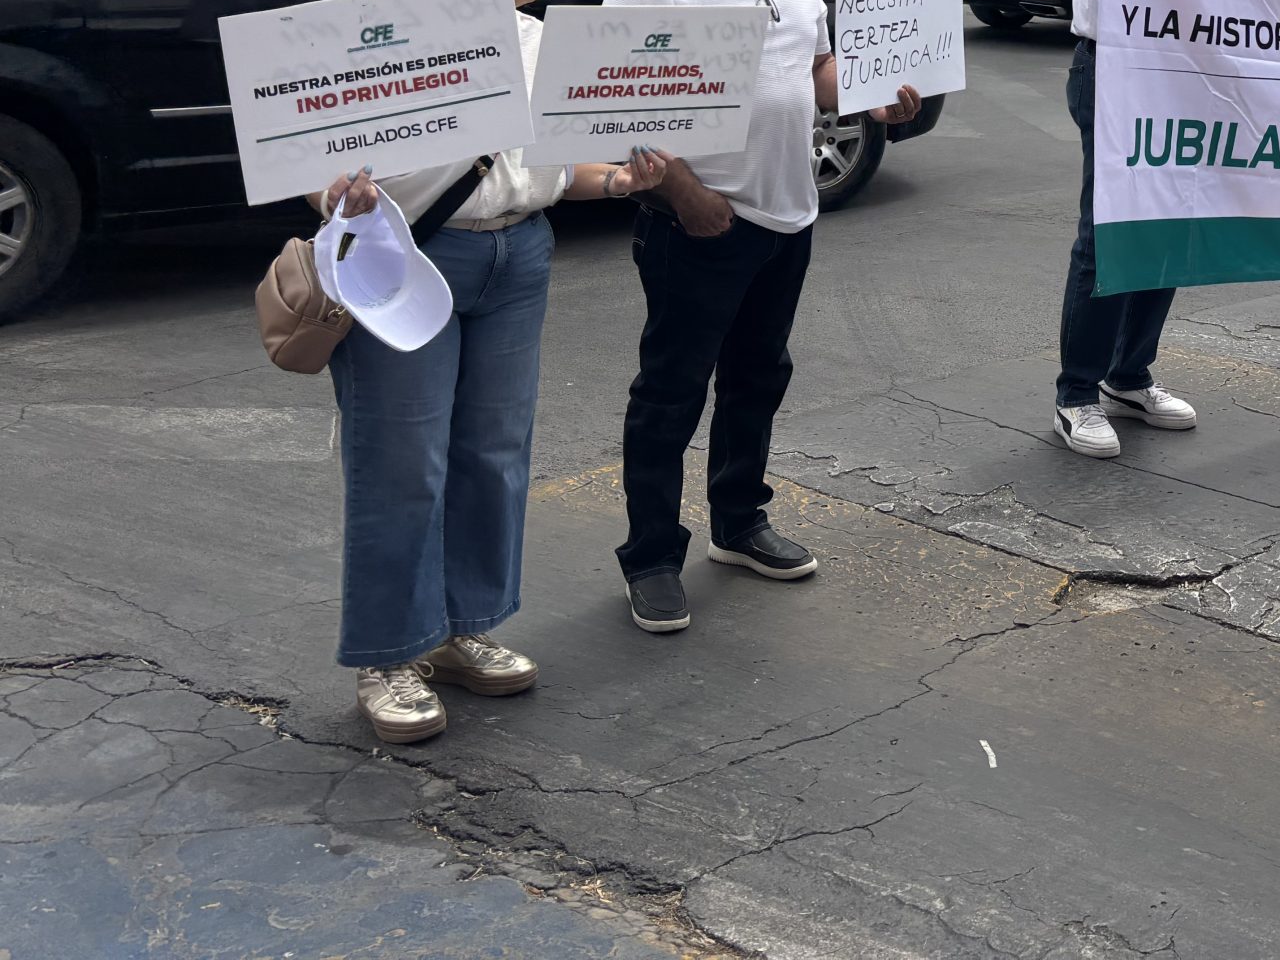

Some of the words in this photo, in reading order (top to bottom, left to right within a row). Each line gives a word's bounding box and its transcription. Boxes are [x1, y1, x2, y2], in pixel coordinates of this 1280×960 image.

[361, 24, 394, 44] CFE
[840, 18, 919, 53] CERTEZA
[1121, 4, 1139, 36] Y
[1143, 6, 1180, 40] LA
[644, 33, 673, 48] CFE
[253, 76, 331, 99] NUESTRA
[334, 62, 404, 85] PENSIÓN
[406, 57, 426, 72] ES
[427, 46, 501, 69] DERECHO,
[597, 65, 704, 80] CUMPLIMOS,
[297, 93, 338, 113] ¡NO
[342, 68, 469, 105] PRIVILEGIO!
[567, 84, 635, 100] ¡AHORA
[638, 82, 726, 97] CUMPLAN!
[325, 124, 423, 155] JUBILADOS
[426, 116, 459, 134] CFE
[589, 120, 666, 135] JUBILADOS
[668, 119, 694, 130] CFE
